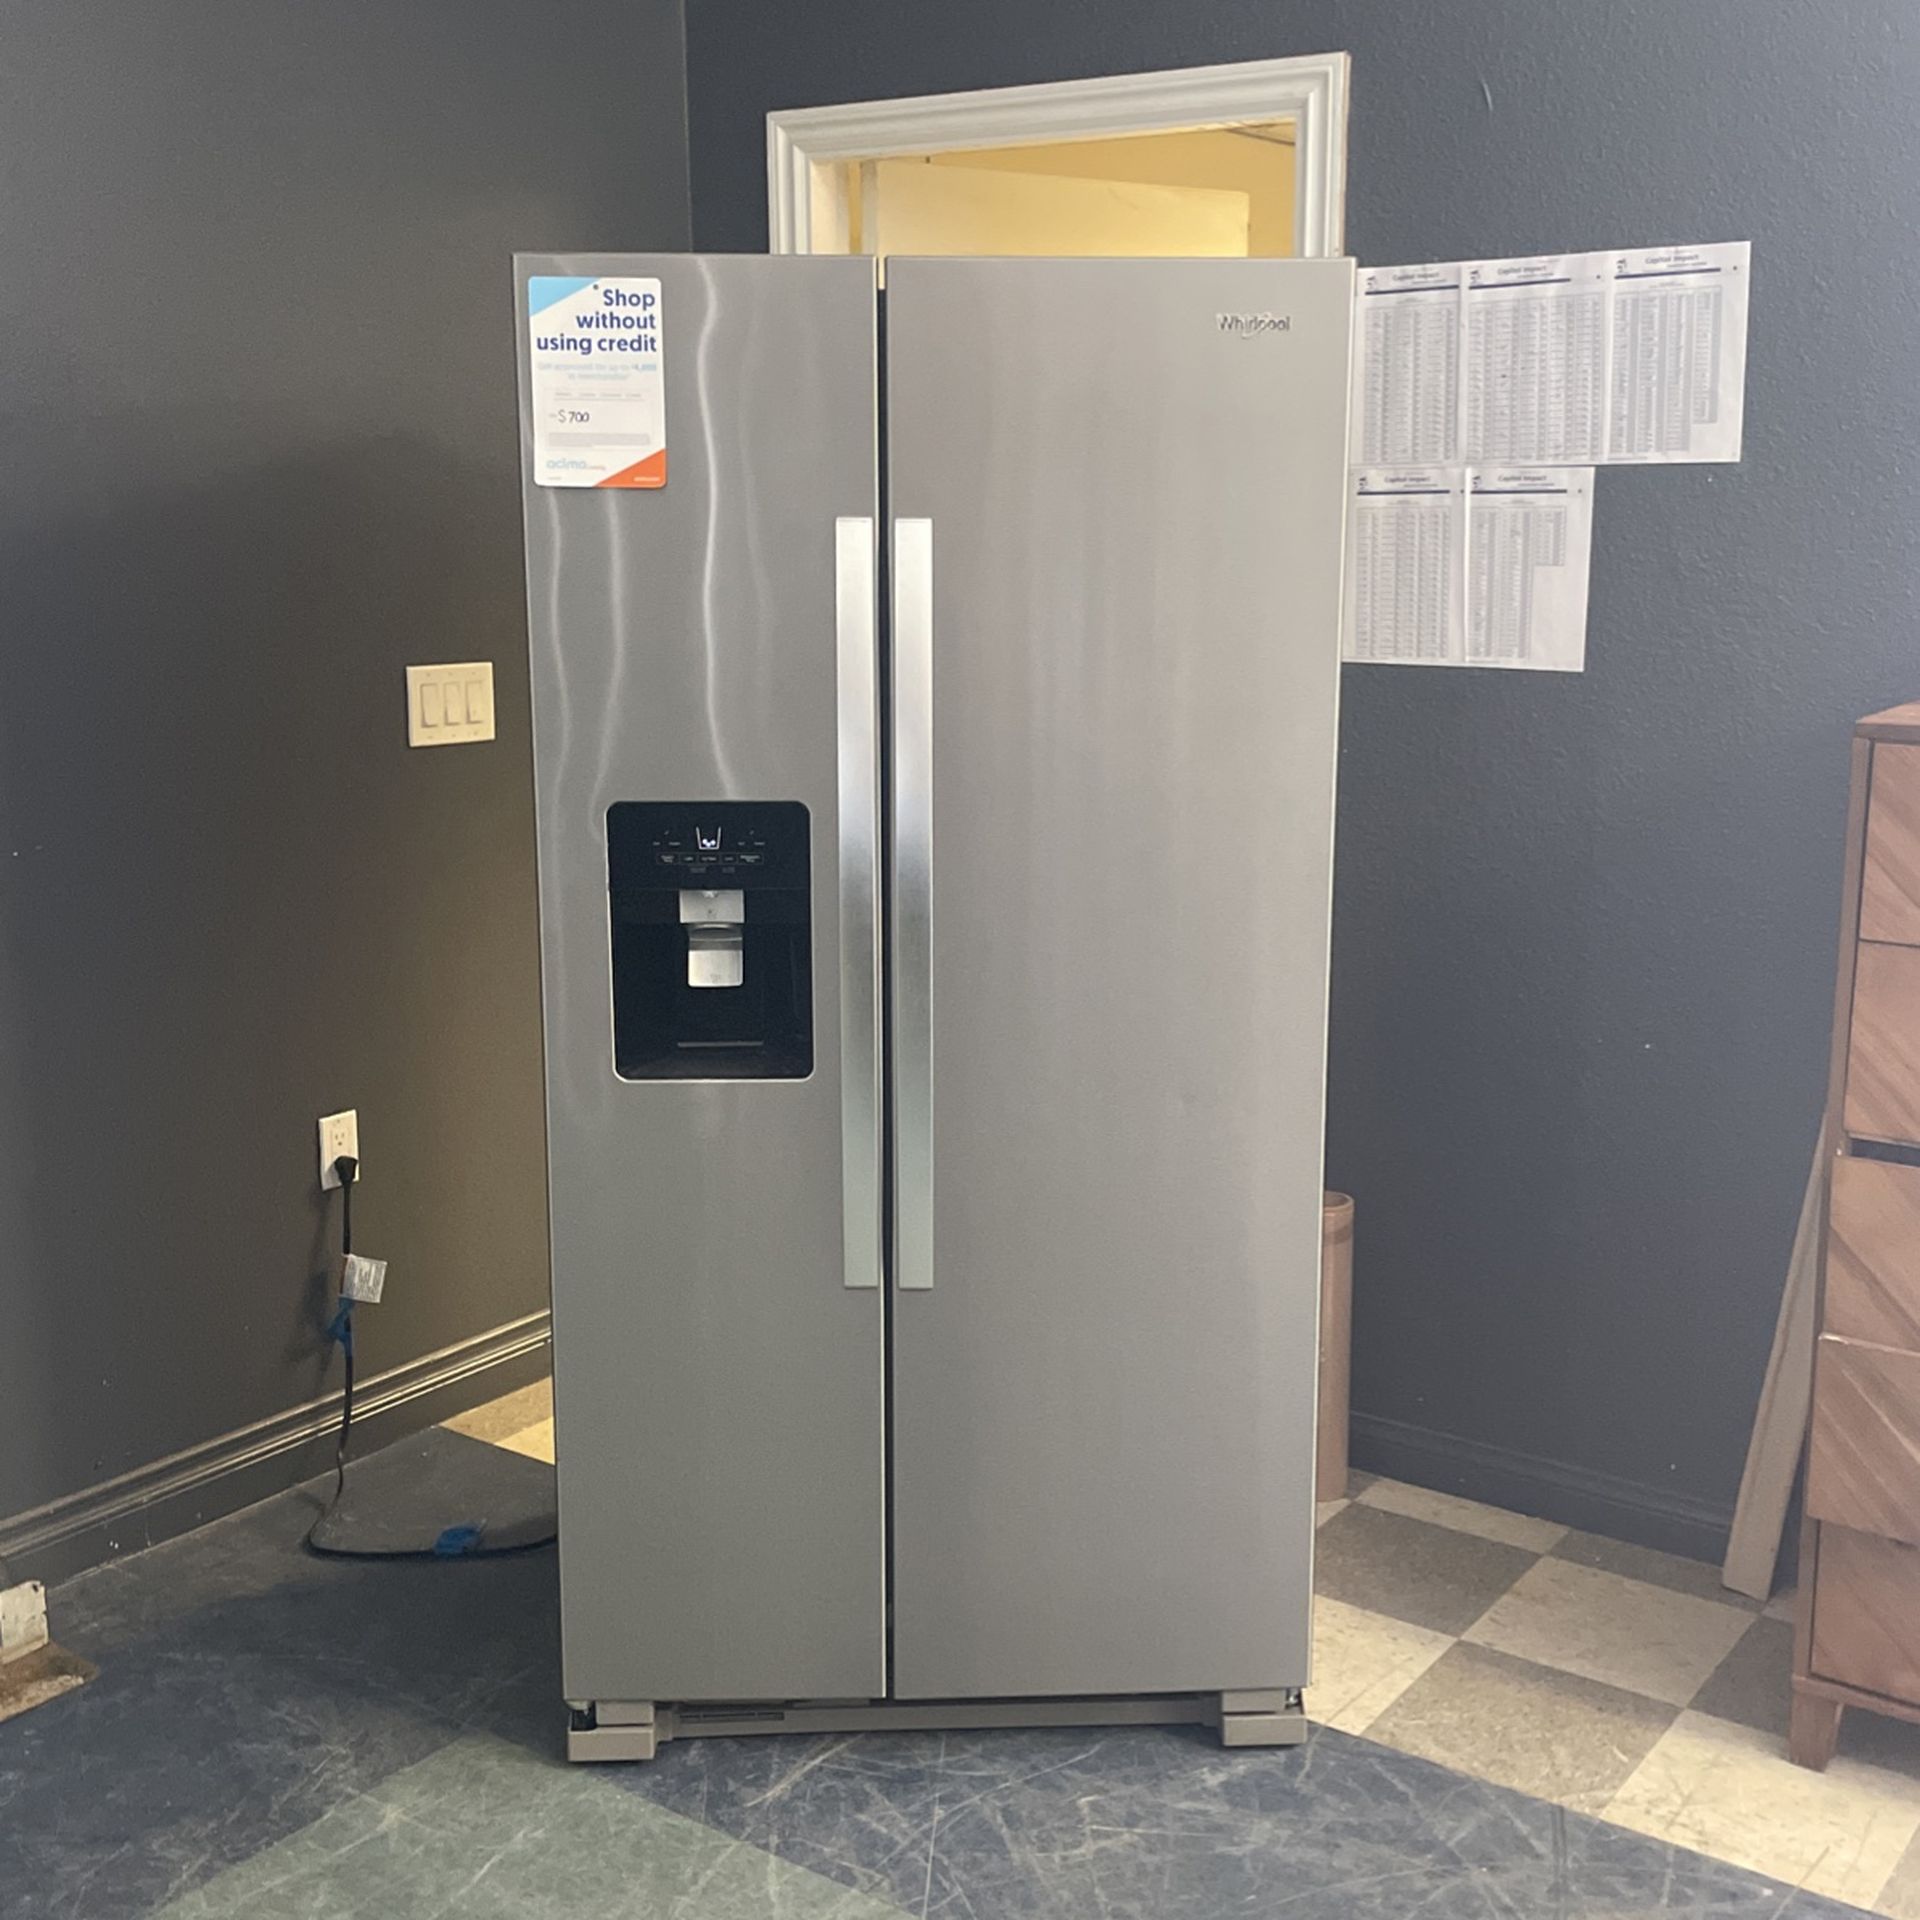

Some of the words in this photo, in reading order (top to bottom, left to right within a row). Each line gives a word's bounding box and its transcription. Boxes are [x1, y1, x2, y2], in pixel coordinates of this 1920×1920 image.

[602, 288, 656, 311] Shop
[576, 311, 656, 330] without
[536, 333, 592, 355] using
[597, 334, 657, 353] credit
